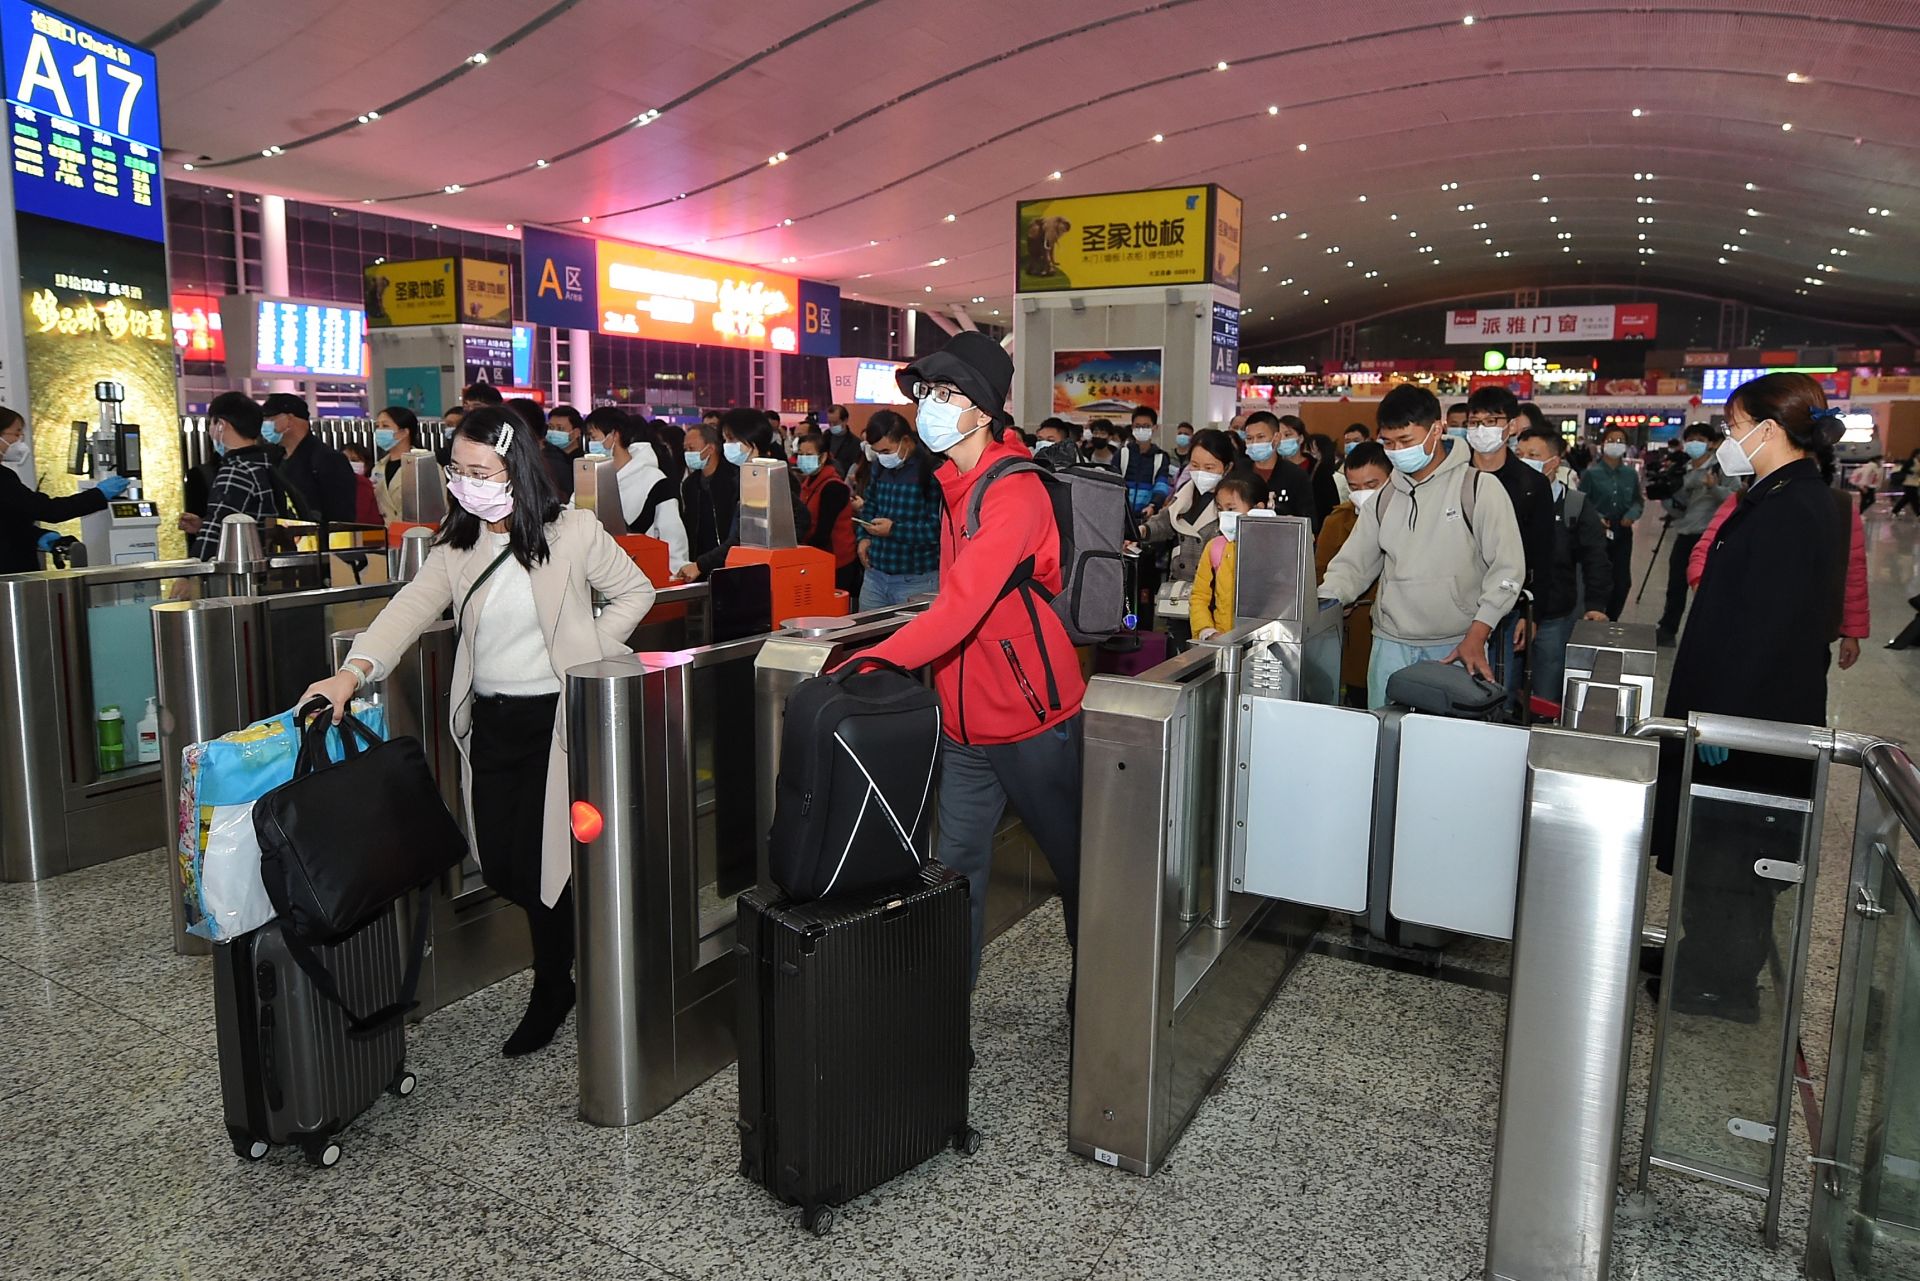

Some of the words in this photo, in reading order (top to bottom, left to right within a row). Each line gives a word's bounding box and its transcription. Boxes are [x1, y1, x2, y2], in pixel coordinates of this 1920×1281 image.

[17, 33, 143, 136] A17
[1081, 218, 1185, 252] 圣象地板
[395, 278, 446, 301] 圣象地板
[537, 258, 563, 300] A
[566, 266, 582, 291] 区
[806, 302, 818, 333] B
[820, 308, 831, 326] 区
[1482, 314, 1578, 335] 派雅门窗
[476, 367, 489, 383] A
[1101, 1152, 1112, 1163] E2
